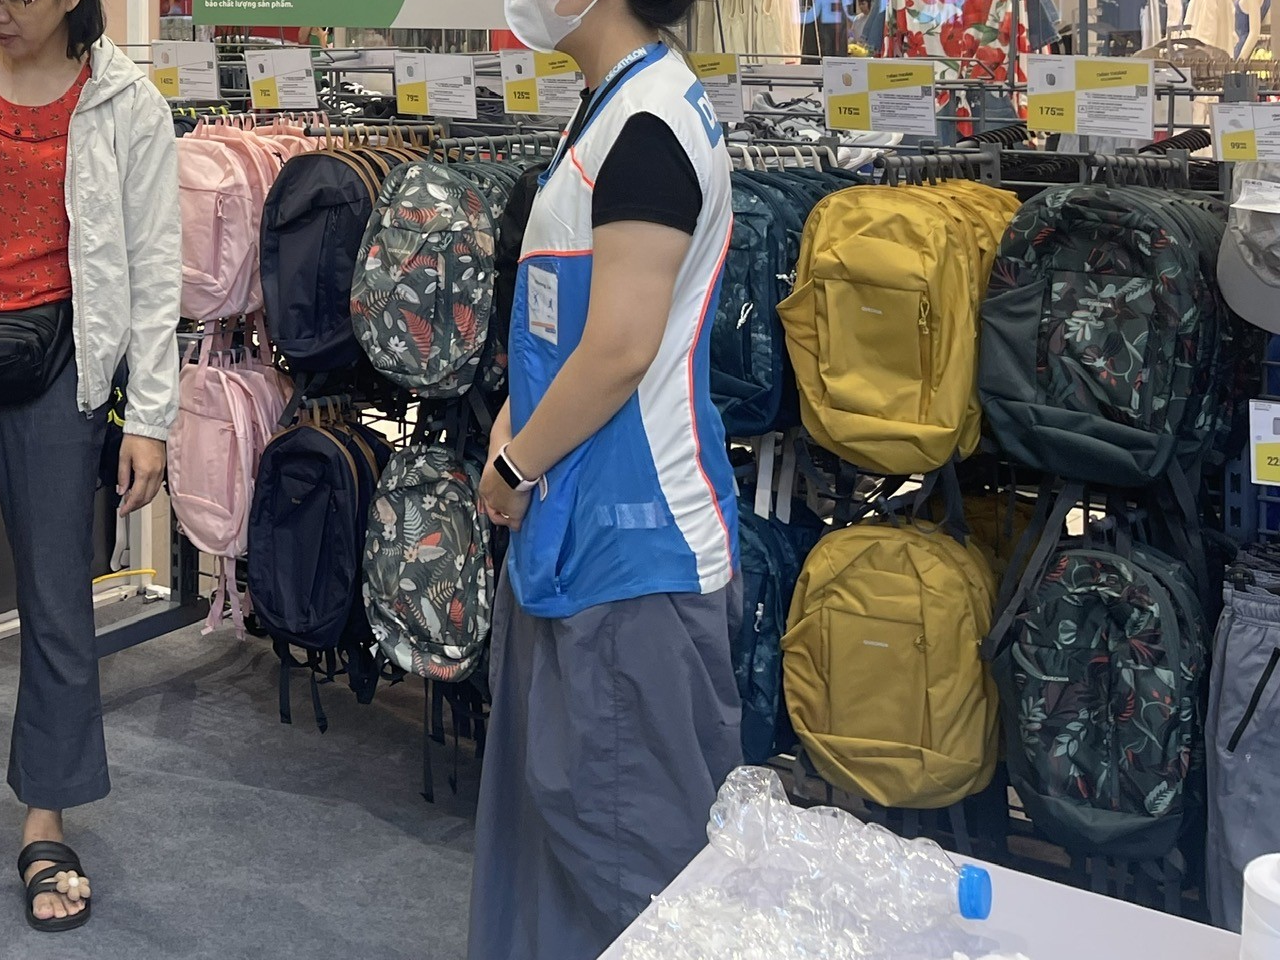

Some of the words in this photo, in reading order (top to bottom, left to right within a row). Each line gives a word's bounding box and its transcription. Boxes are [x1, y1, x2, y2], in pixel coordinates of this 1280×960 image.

[219, 0, 234, 7] chất
[235, 0, 256, 9] lượng
[605, 46, 647, 82] DECATHLON
